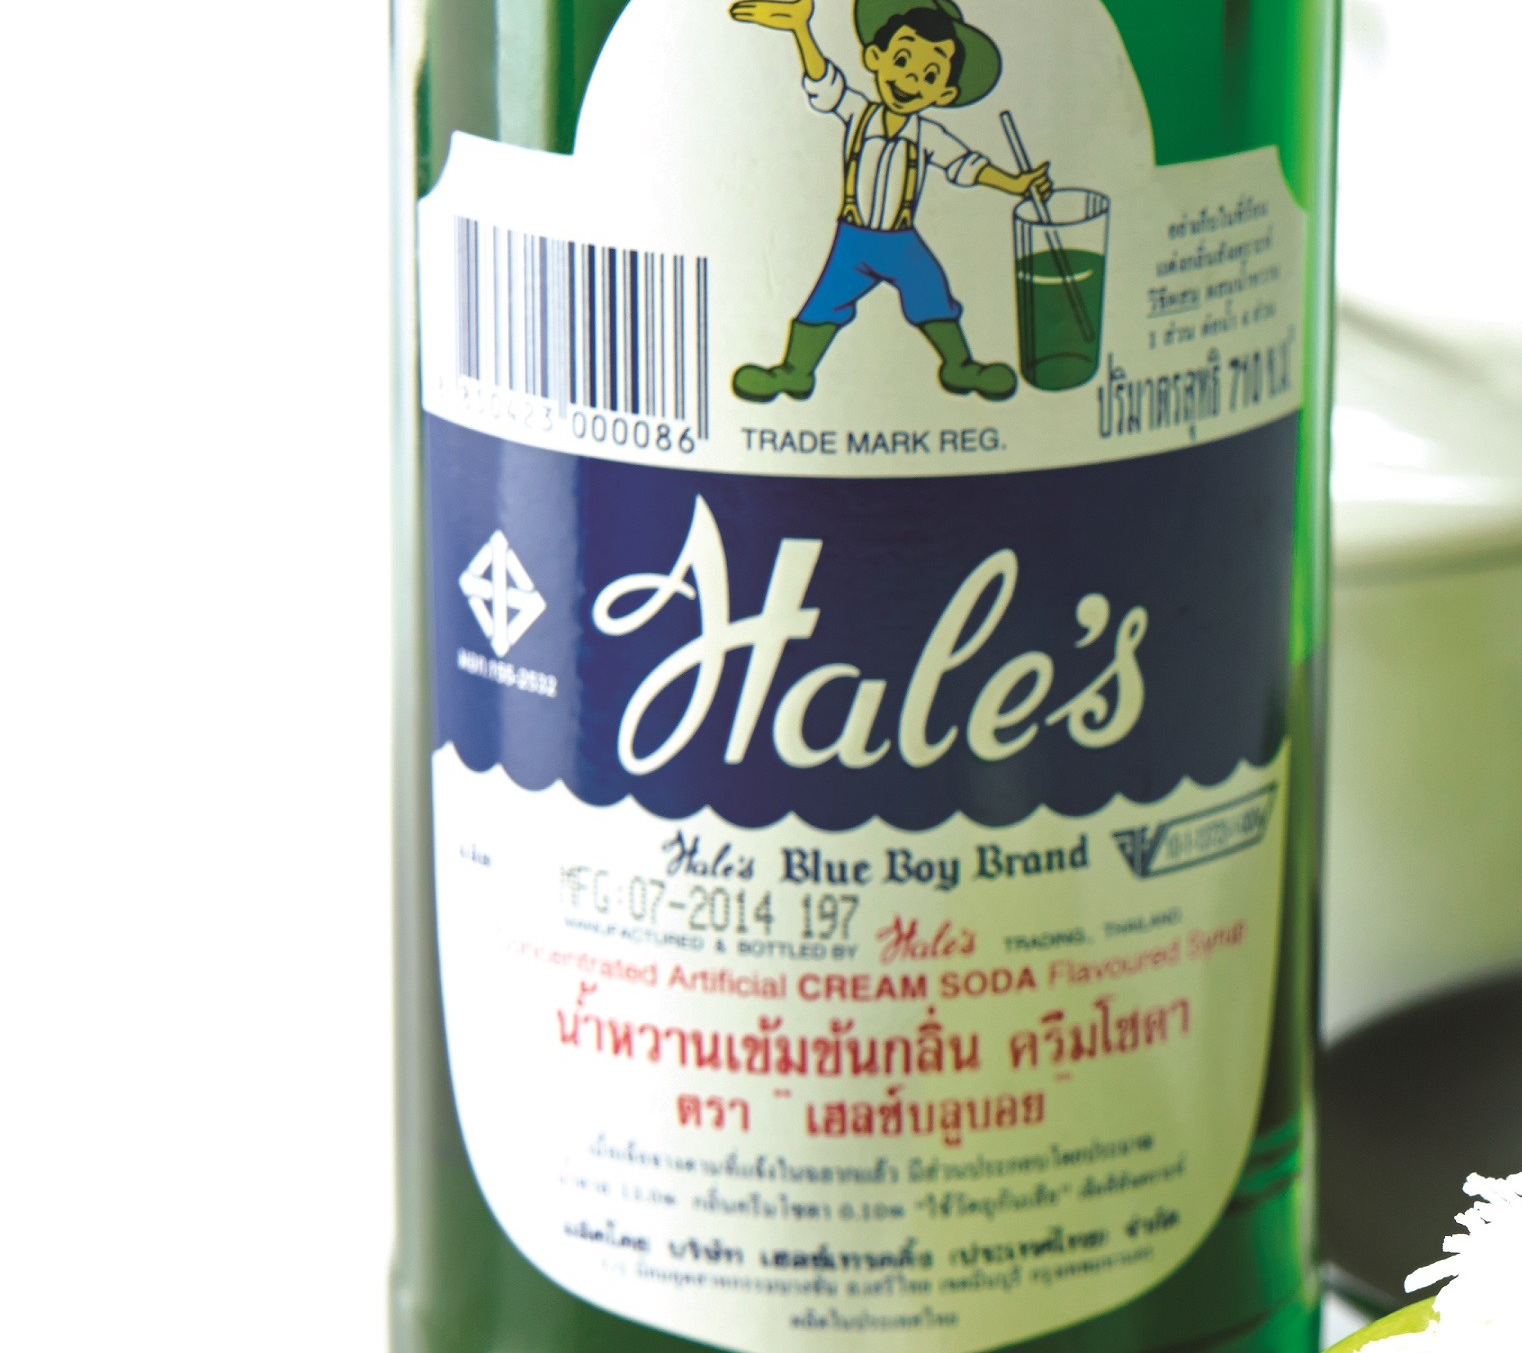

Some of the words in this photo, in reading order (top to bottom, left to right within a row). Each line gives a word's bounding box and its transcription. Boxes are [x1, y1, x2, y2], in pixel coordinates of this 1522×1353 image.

[572, 410, 696, 455] 000086
[741, 426, 838, 456] TRADE
[847, 428, 932, 458] MARK
[939, 428, 1008, 457] REG.
[592, 493, 1149, 777] Hale's
[661, 829, 756, 882] Hale's
[780, 846, 873, 887] Blue
[883, 848, 961, 892] Boy
[975, 834, 1089, 882] Brand
[738, 939, 829, 961] BOTTLED
[832, 942, 861, 962] BY
[875, 912, 978, 966] Hale's
[802, 894, 860, 941] 197
[669, 964, 788, 999] Artificial
[797, 973, 928, 1002] CREAM
[940, 965, 1037, 1000] SODA
[1048, 934, 1182, 987] Flavoured
[557, 980, 981, 1077] น้ำหวานเข้มข้นกลิ่น
[677, 1093, 750, 1133] ตรา
